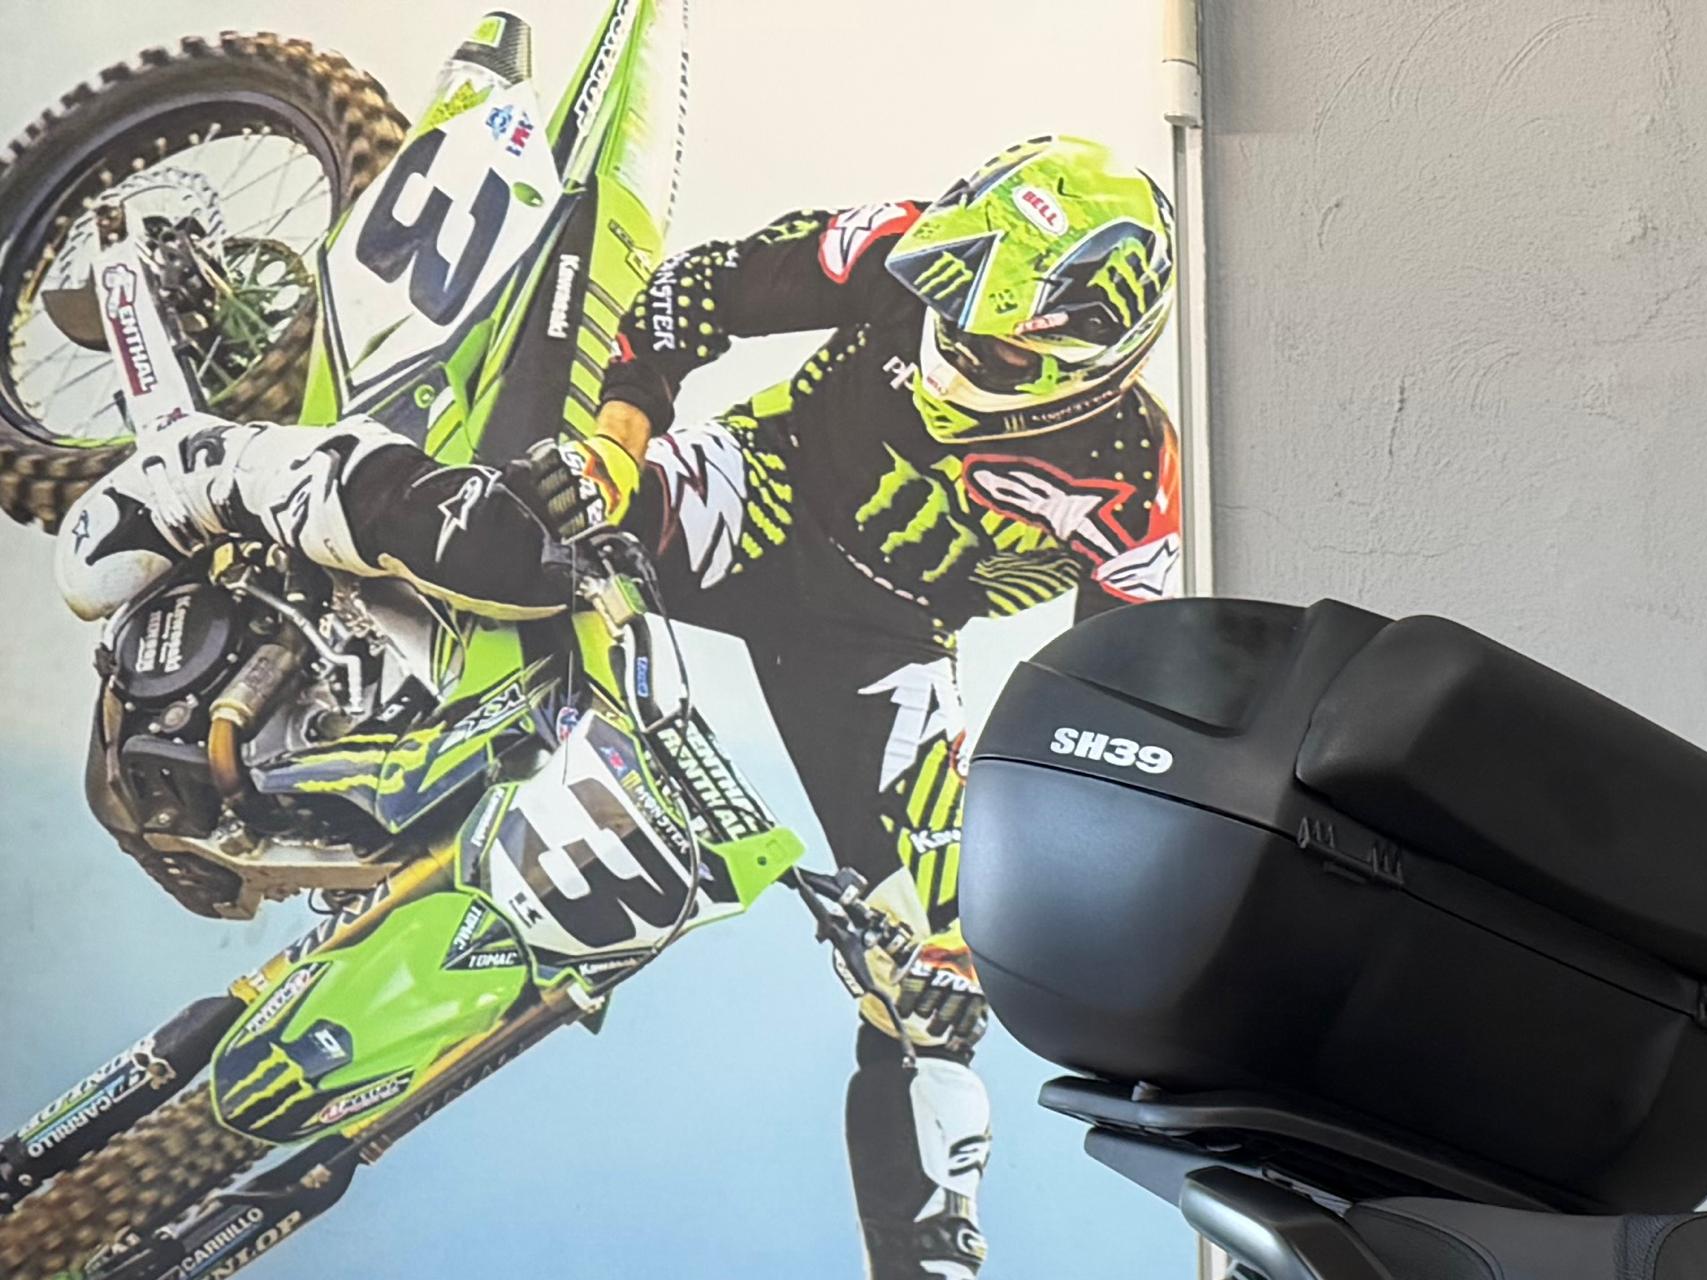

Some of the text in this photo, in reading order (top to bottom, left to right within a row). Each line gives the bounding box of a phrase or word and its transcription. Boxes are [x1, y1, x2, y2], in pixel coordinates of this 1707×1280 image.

[356, 128, 512, 326] 3
[1021, 190, 1057, 227] BELL
[650, 252, 689, 352] ONSTER
[1050, 726, 1173, 776] SH39
[496, 778, 699, 949] 3
[181, 1206, 265, 1272] CARRILLO
